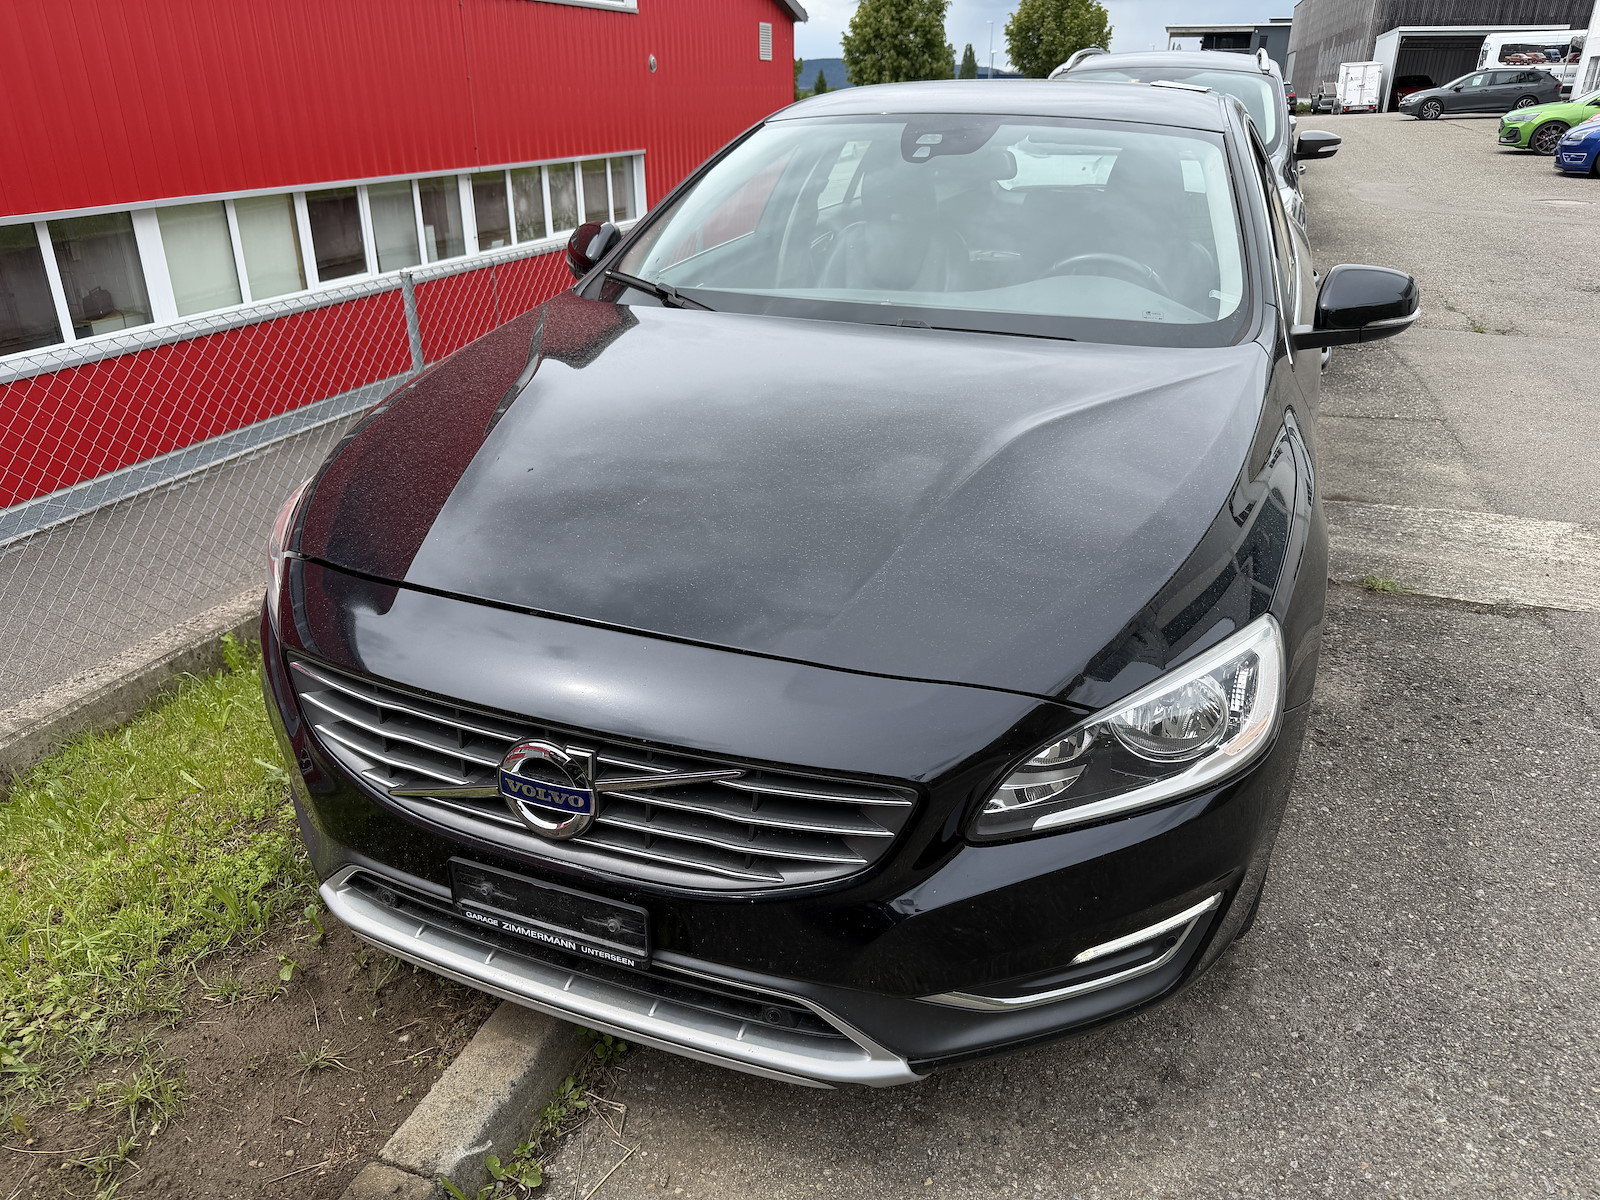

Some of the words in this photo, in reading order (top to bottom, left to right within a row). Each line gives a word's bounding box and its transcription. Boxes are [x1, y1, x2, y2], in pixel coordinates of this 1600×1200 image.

[505, 778, 584, 807] VOLVO
[465, 911, 499, 927] GARAGE
[502, 921, 576, 950] ZIMMERMANN
[581, 945, 635, 967] UNTERSEEN
